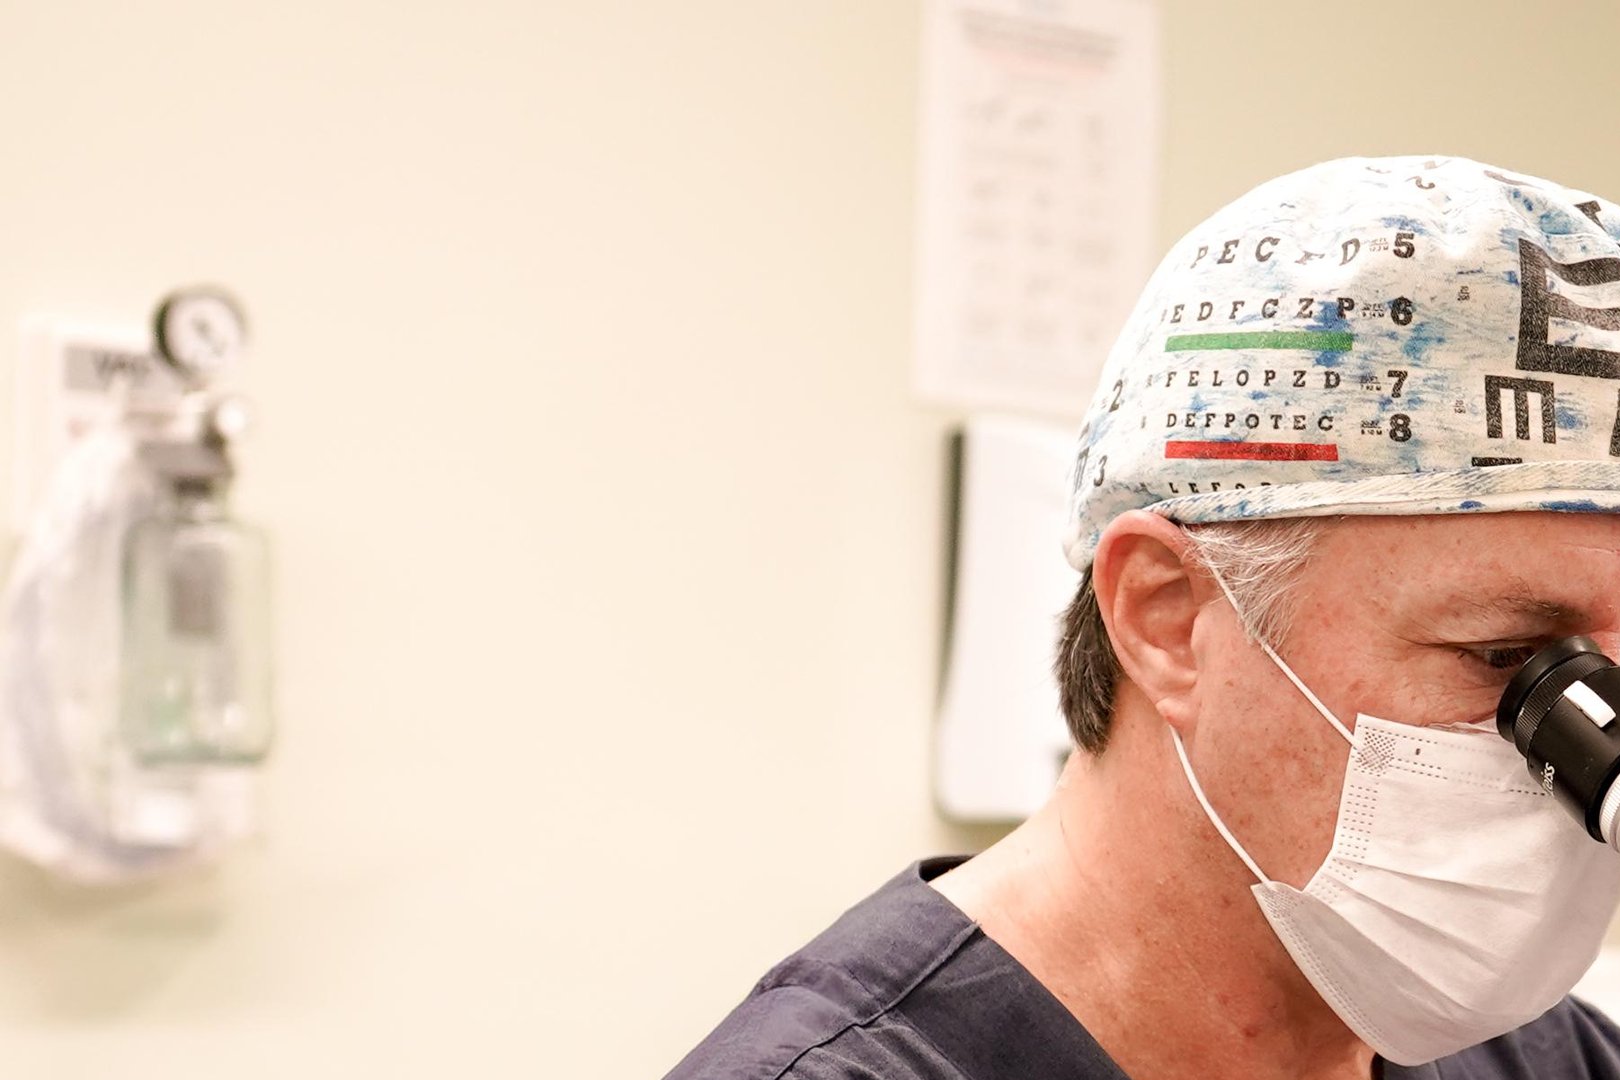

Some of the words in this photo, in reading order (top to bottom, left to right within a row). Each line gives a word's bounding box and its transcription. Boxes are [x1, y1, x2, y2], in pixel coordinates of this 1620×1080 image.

[1393, 232, 1415, 258] 5
[1391, 295, 1413, 326] 6
[1108, 379, 1123, 413] 2
[1387, 370, 1408, 398] 7
[1389, 413, 1412, 442] 8
[1093, 455, 1108, 487] 3
